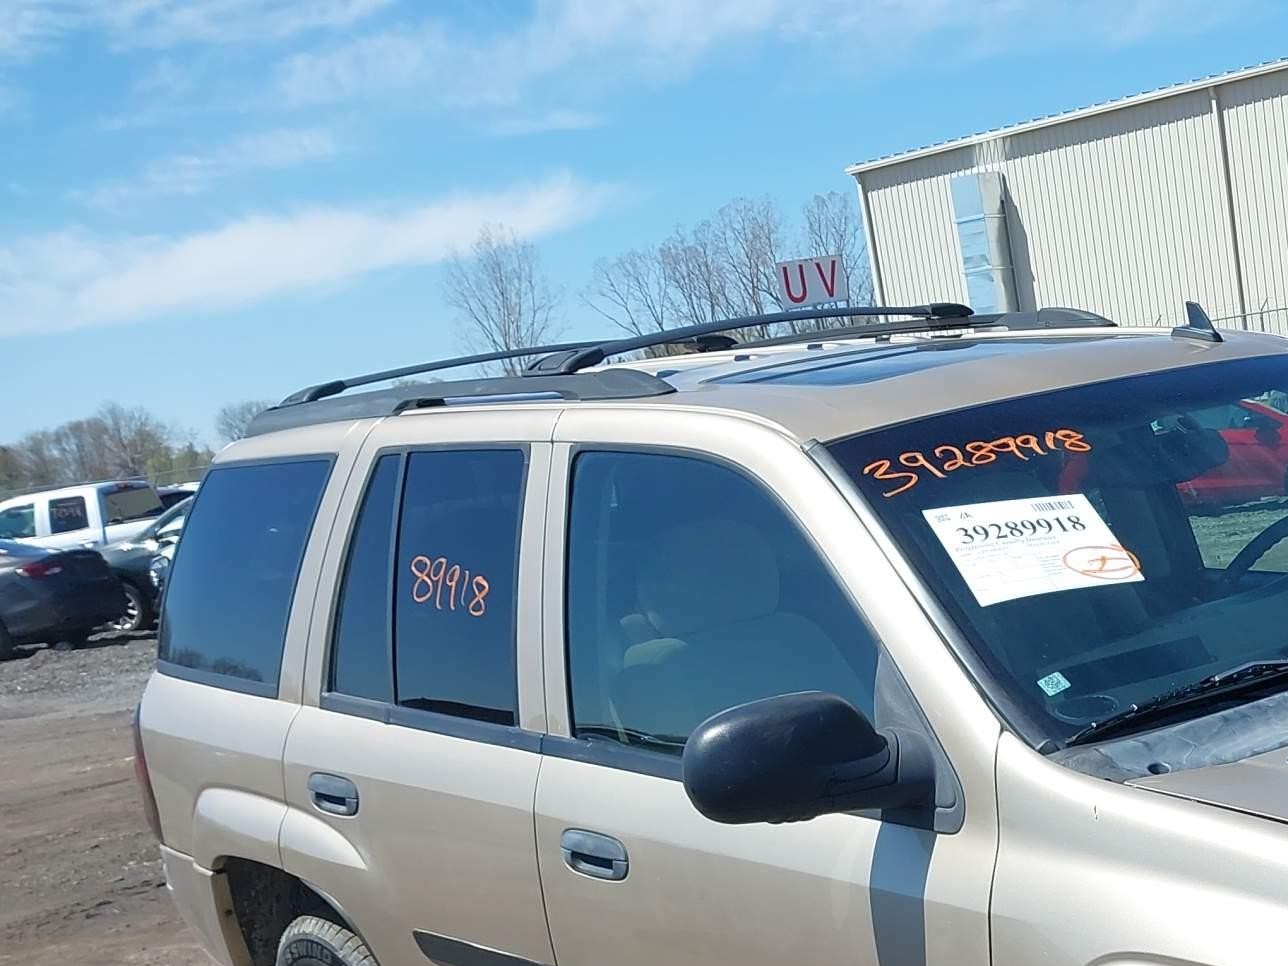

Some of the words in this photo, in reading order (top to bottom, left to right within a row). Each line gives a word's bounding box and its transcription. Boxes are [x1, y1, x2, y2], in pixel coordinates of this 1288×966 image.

[863, 429, 1092, 498] 39289918
[956, 515, 1086, 544] 39289918
[411, 555, 489, 617] 89918
